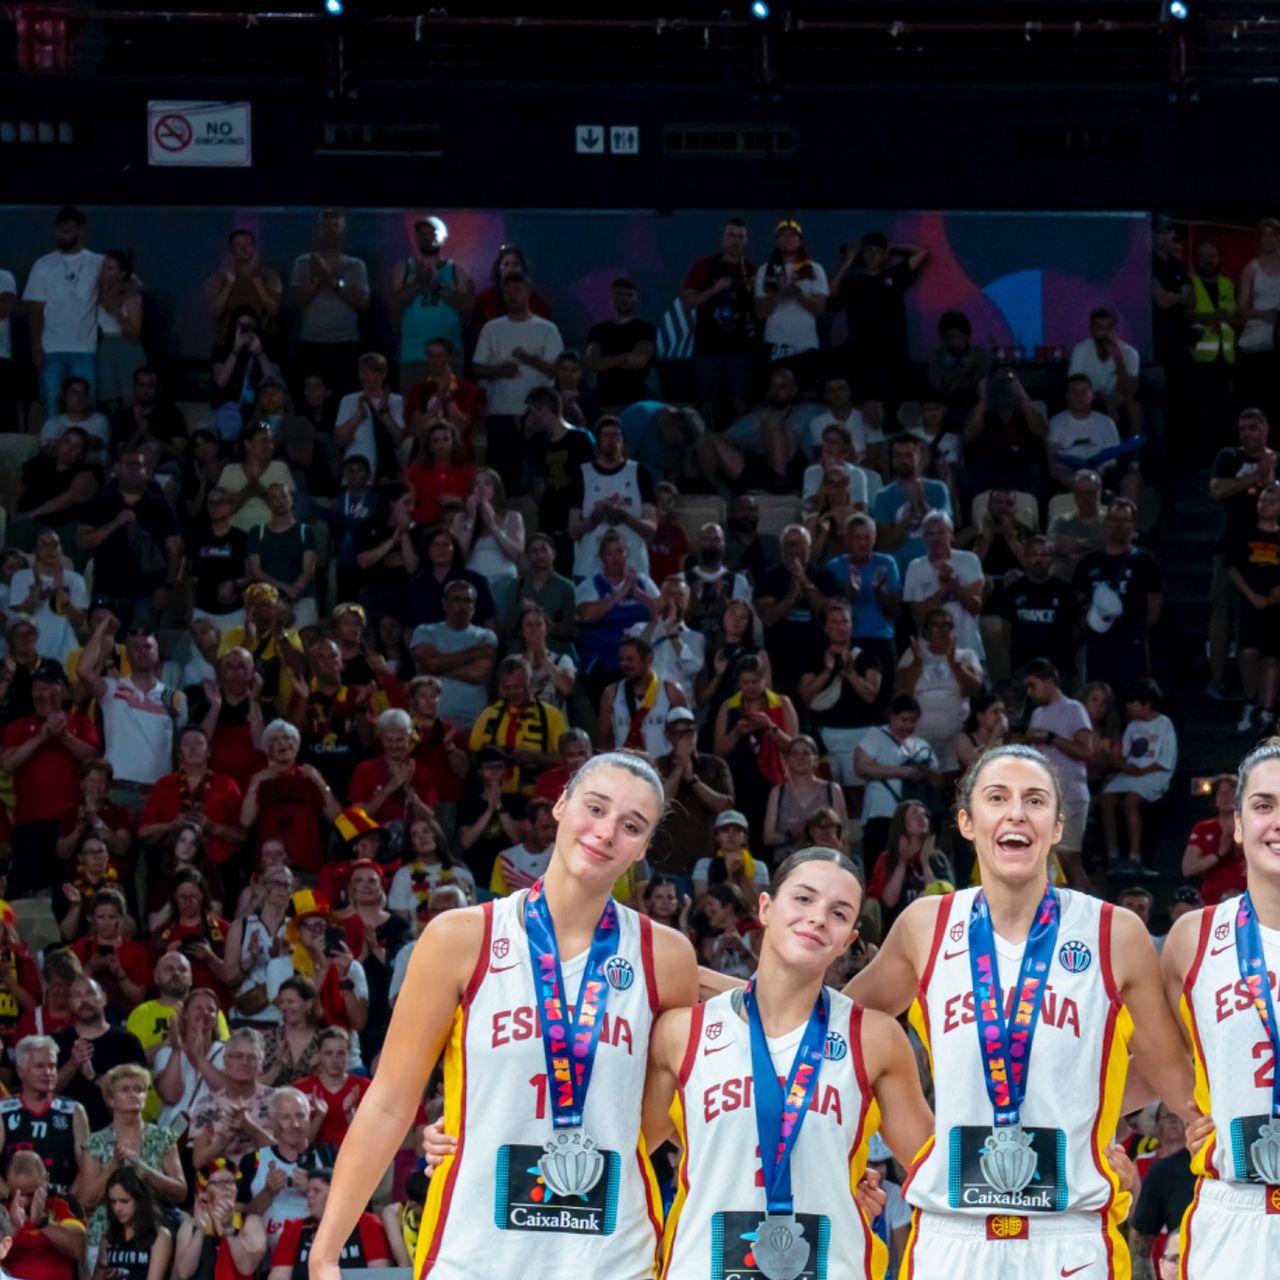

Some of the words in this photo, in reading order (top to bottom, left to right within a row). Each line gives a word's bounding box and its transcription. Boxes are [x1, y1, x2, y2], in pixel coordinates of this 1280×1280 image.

[206, 121, 232, 136] NO
[491, 1005, 633, 1056] ESA
[703, 1076, 842, 1126] ESA
[963, 1188, 1052, 1208] CaixaBank
[510, 1207, 600, 1231] CaixaBank
